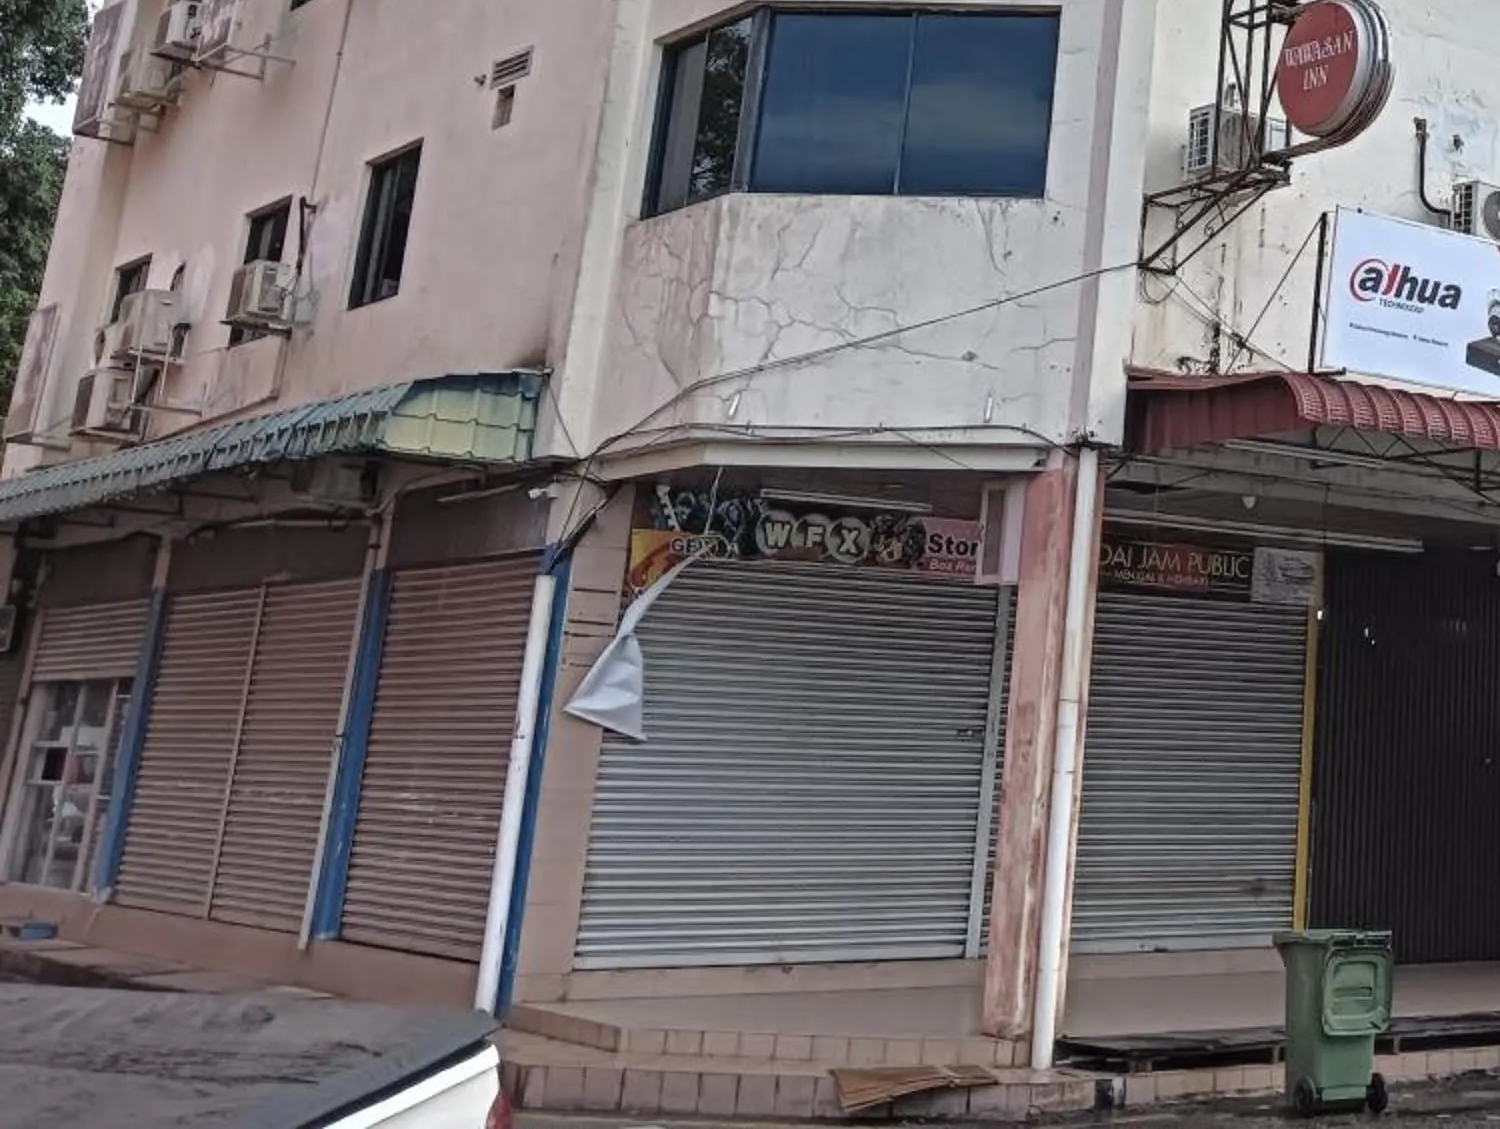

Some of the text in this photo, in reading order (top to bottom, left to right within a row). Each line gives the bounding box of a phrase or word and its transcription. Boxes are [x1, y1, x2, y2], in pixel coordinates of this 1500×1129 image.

[1303, 64, 1329, 91] INN
[928, 533, 979, 557] Stor
[1100, 543, 1133, 567] DAI
[1138, 549, 1181, 573] JAM
[1187, 552, 1249, 578] PUBLIC
